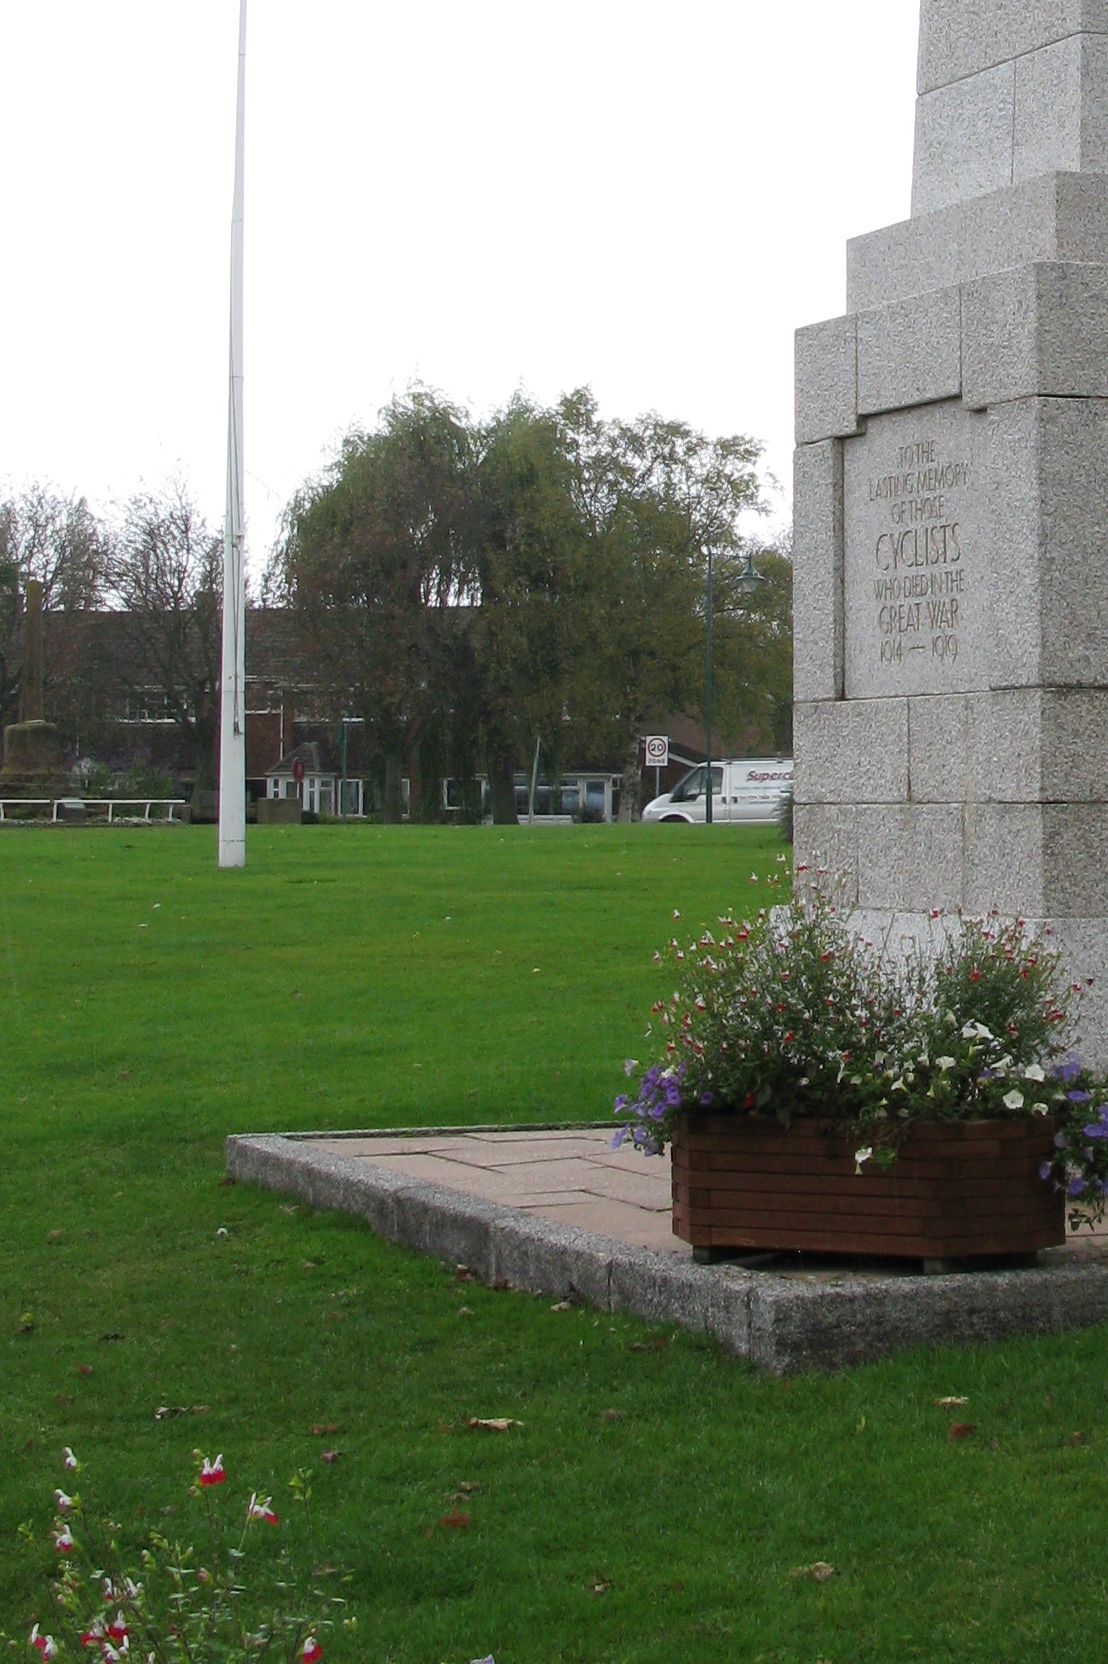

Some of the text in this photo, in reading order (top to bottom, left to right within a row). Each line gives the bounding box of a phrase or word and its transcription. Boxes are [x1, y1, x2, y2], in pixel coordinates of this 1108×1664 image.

[898, 440, 936, 469] TO THE
[869, 462, 968, 502] LASTING MEMORY
[891, 495, 944, 524] OF THOSE
[875, 522, 961, 571] CYCLISTS
[873, 569, 964, 601] WHO DIED IN THE
[878, 598, 959, 634] GREAT WAR
[881, 636, 903, 664] 1914
[931, 635, 958, 662] 1919
[650, 743, 664, 751] 20
